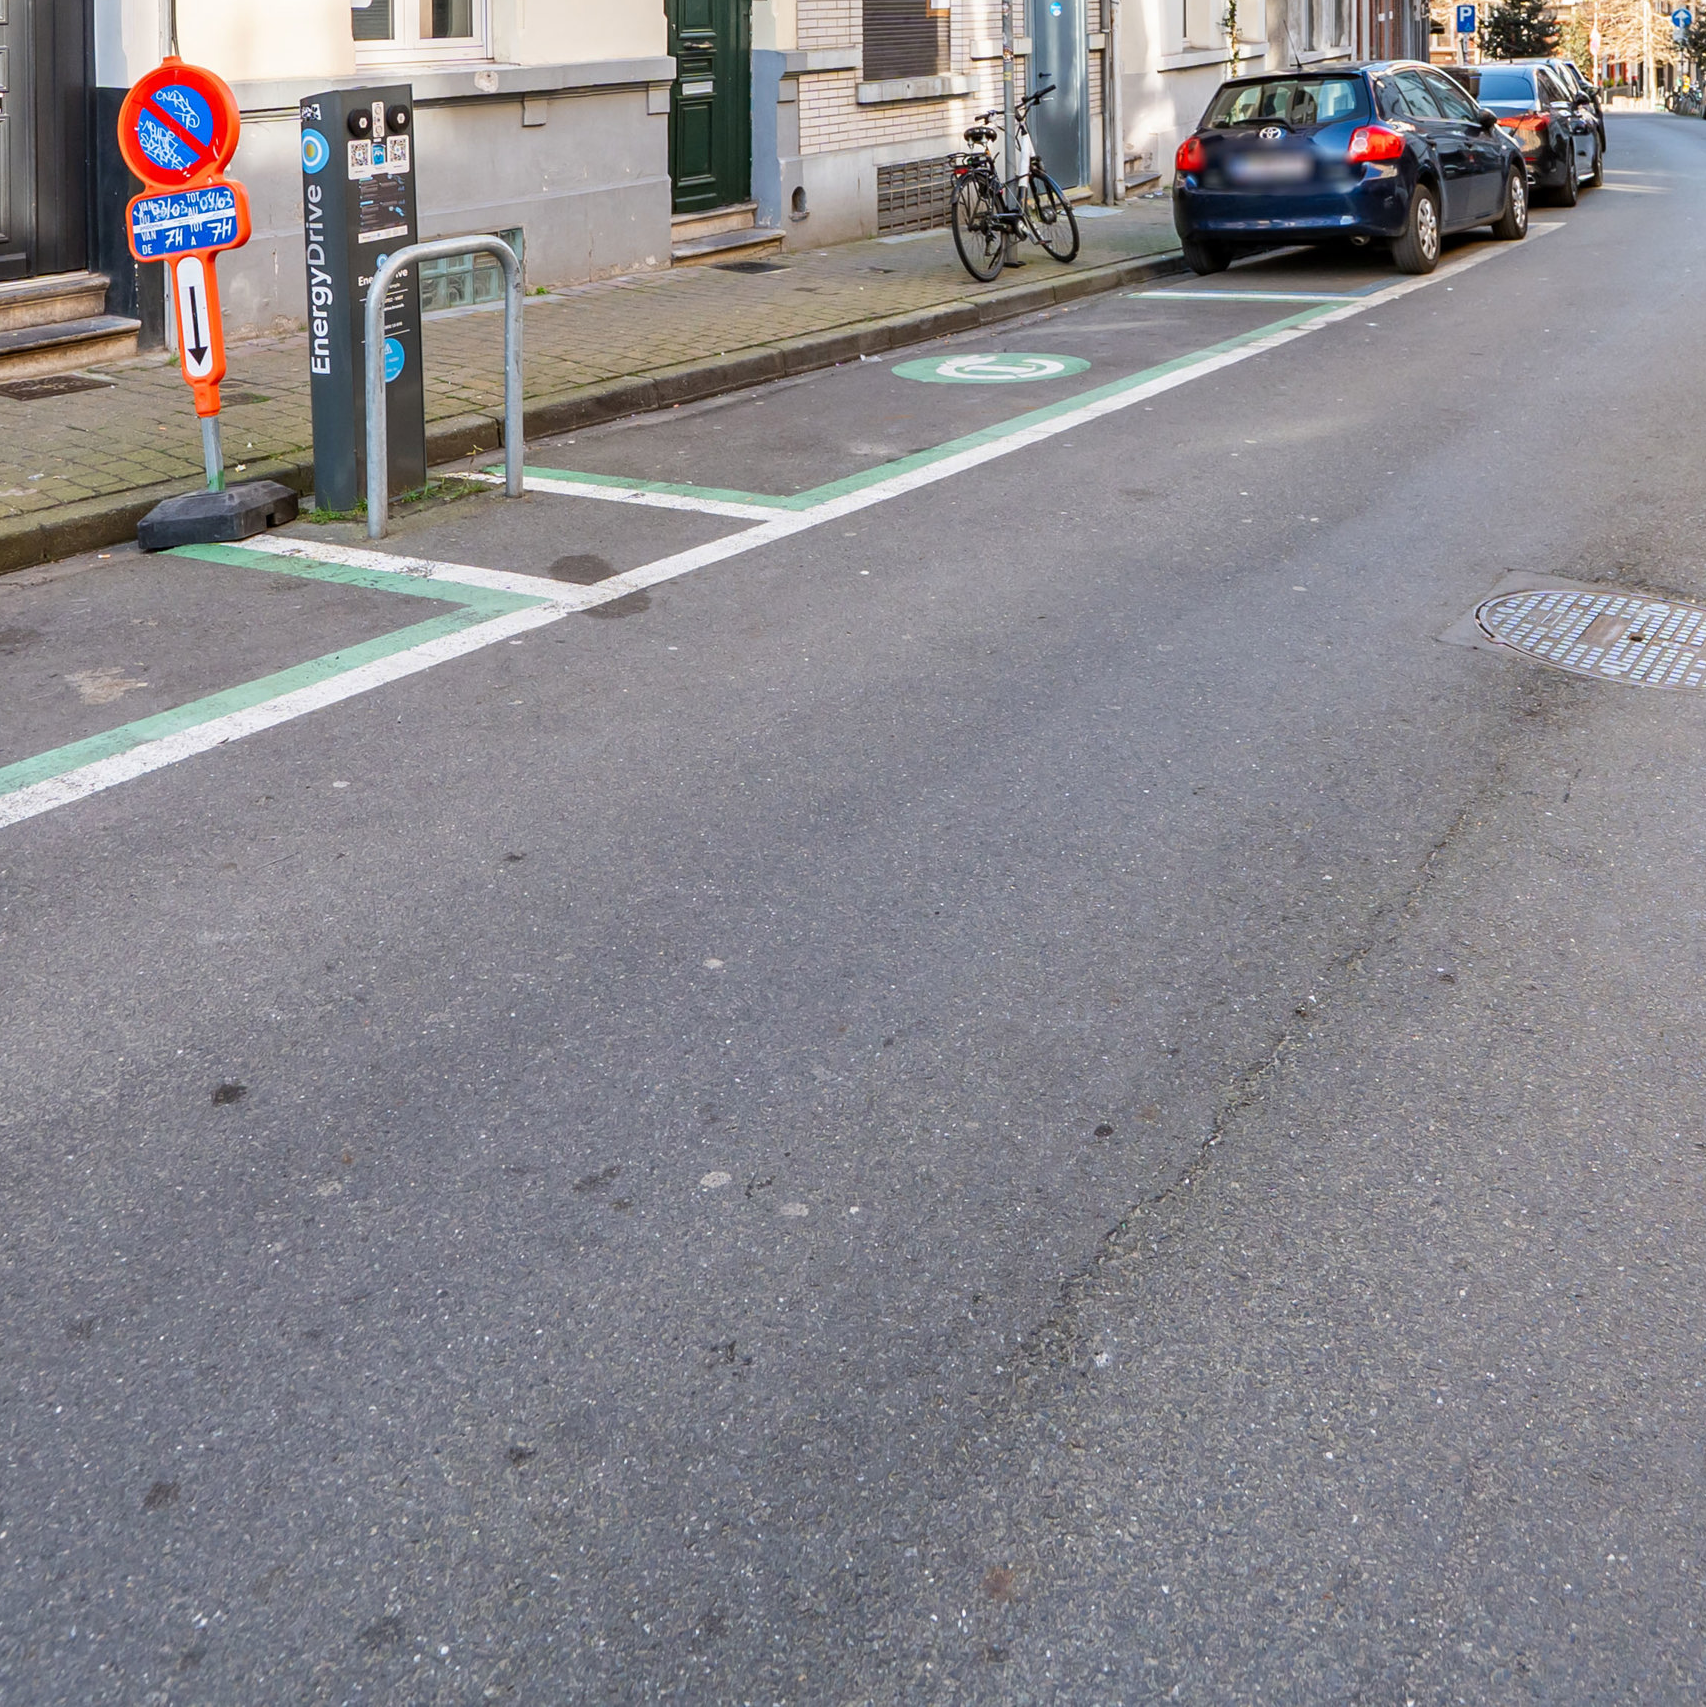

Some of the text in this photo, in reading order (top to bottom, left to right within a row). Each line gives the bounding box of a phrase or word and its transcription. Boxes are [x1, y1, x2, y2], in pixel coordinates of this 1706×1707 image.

[1459, 6, 1472, 22] P
[186, 192, 200, 203] TOT
[138, 201, 153, 212] VAN
[188, 206, 199, 216] AU
[190, 222, 203, 233] TOT
[207, 219, 232, 242] 7H
[141, 230, 157, 242] VAN
[165, 228, 183, 248] 7H
[191, 236, 197, 246] A
[142, 244, 153, 255] DE
[306, 184, 333, 375] EnergyDrive
